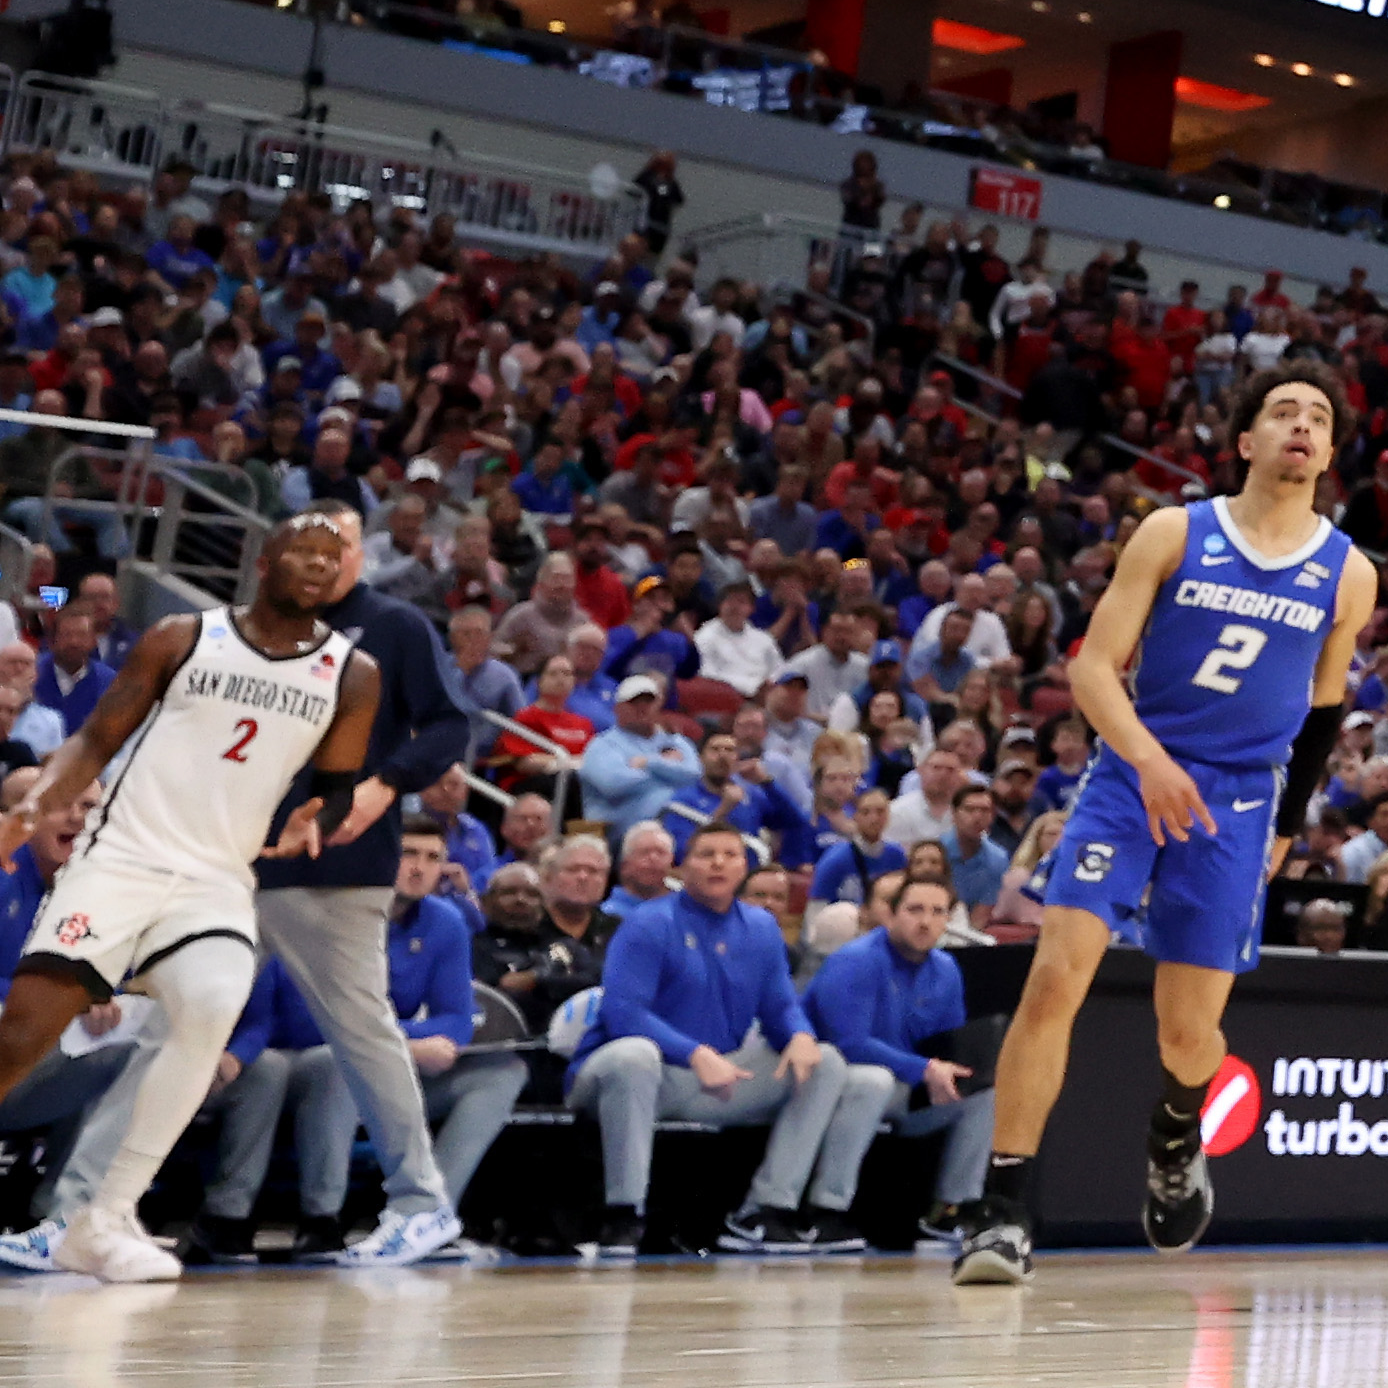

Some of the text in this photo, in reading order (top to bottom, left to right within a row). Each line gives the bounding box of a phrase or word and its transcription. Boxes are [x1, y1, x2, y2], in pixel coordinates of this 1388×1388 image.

[1174, 579, 1327, 633] CREIGHTON
[1191, 623, 1269, 695] 2
[185, 667, 329, 726] SAN DIEGO STATE
[222, 717, 259, 763] 2
